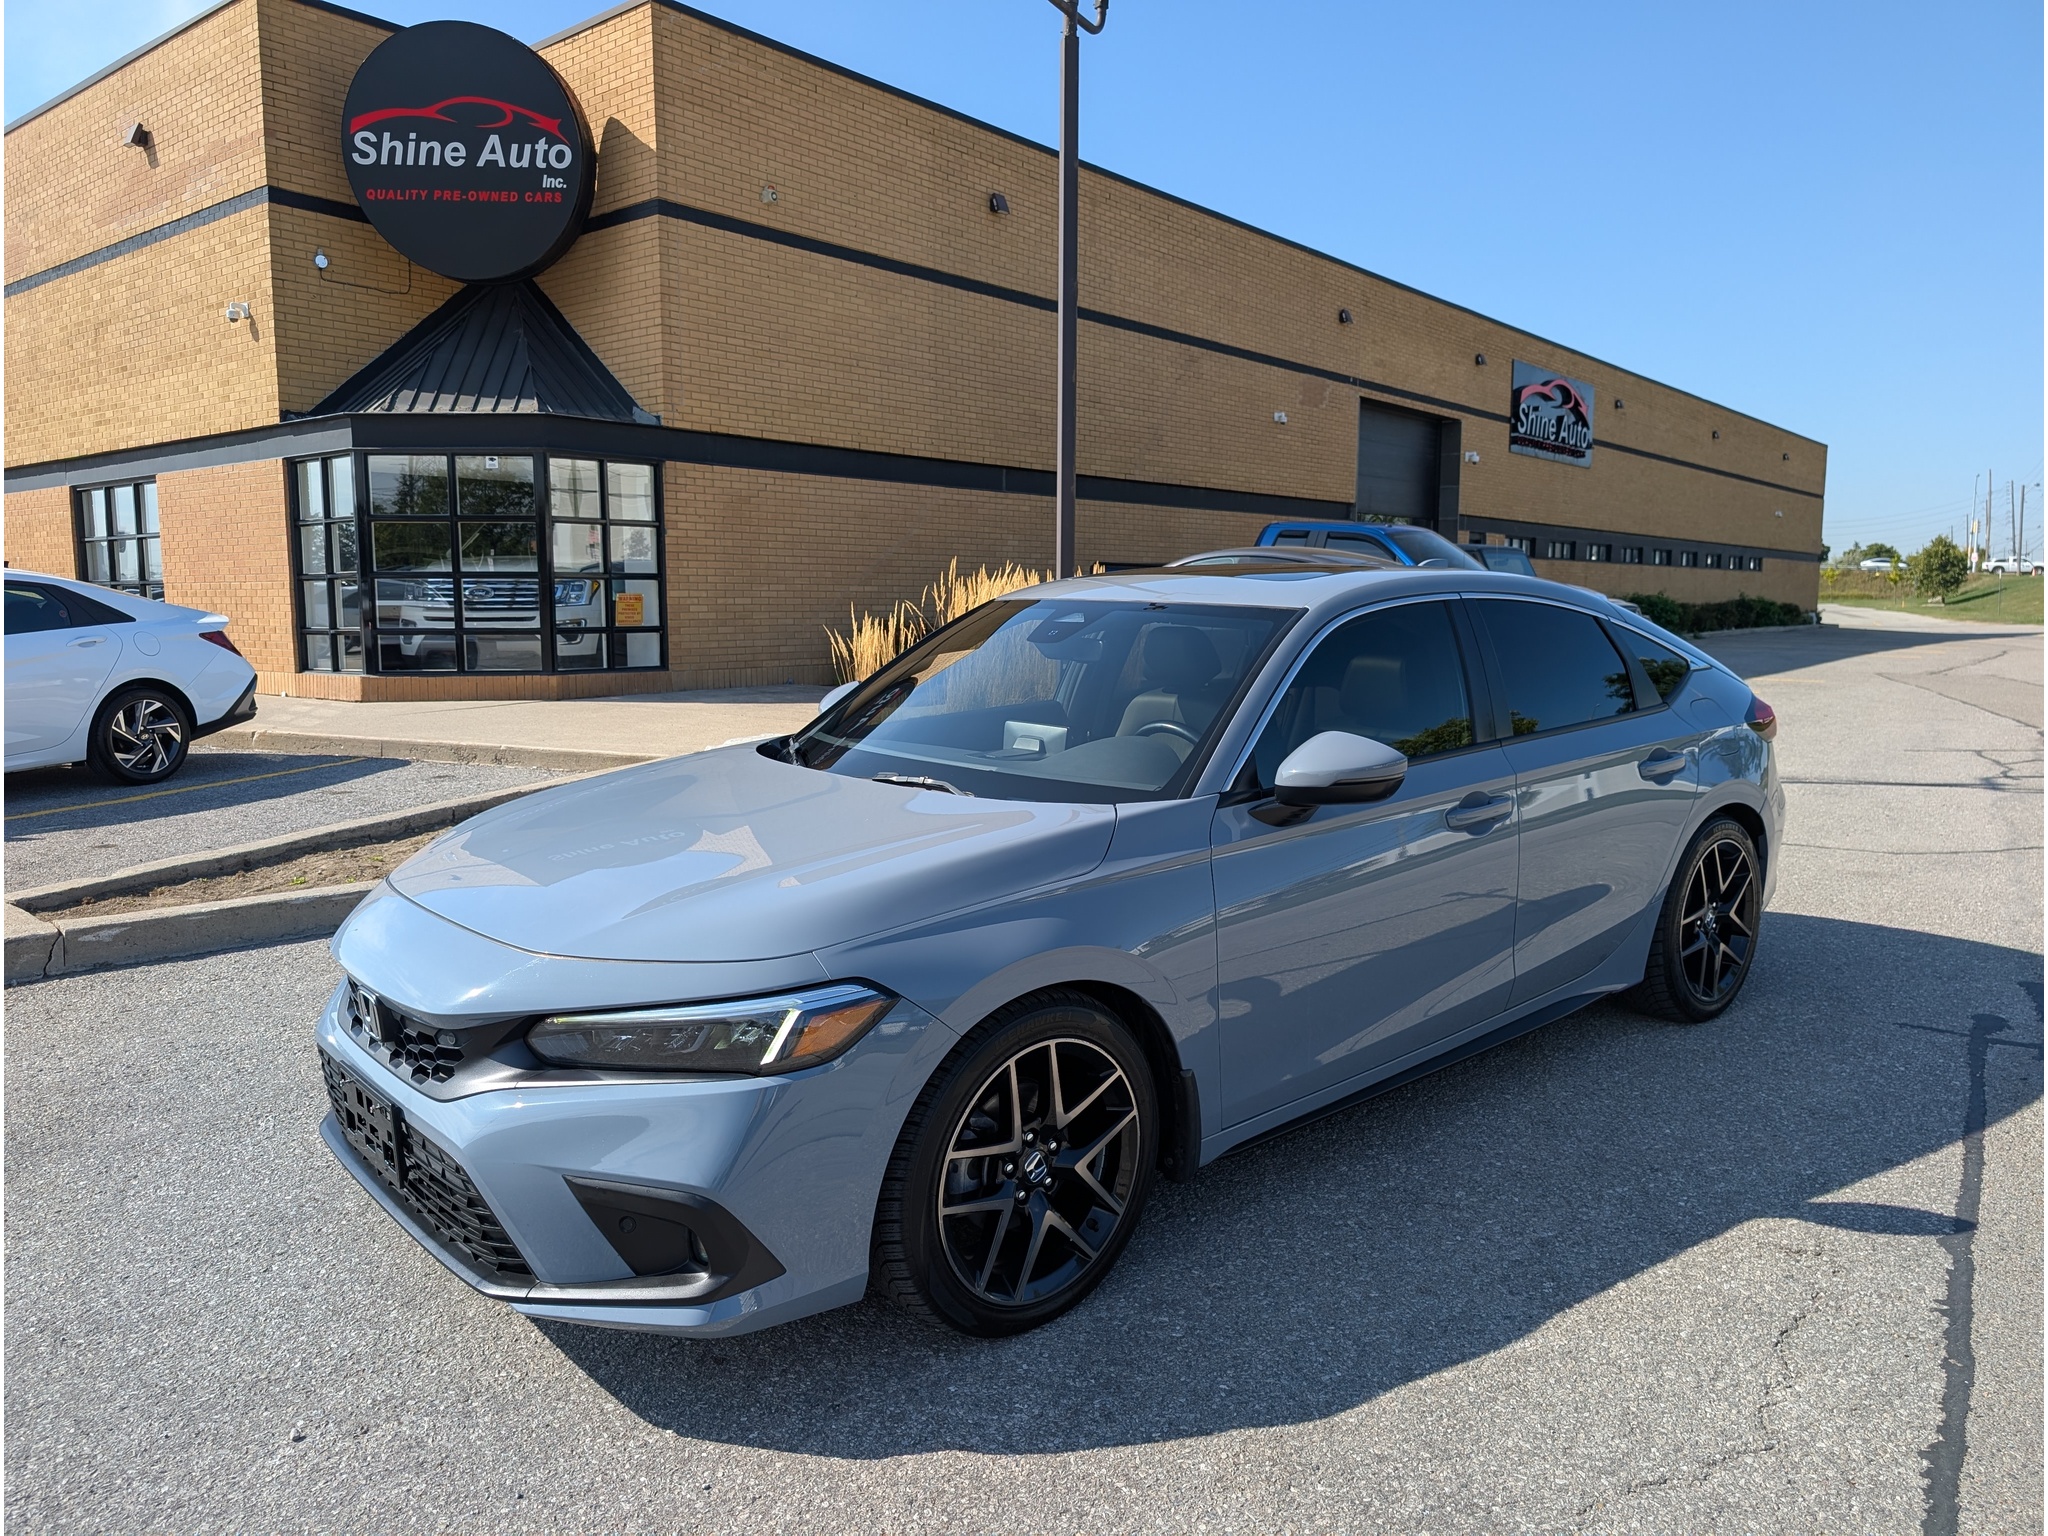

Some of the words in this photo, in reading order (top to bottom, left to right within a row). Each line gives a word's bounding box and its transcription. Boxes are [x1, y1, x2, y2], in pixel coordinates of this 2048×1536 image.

[351, 130, 466, 167] Shine
[476, 134, 573, 169] Auto
[542, 174, 567, 189] Inc.
[366, 188, 428, 200] QUALITY
[433, 190, 519, 202] PRE-OWNED
[524, 191, 563, 203] CARS
[1517, 403, 1557, 441] Shine
[1559, 415, 1590, 449] Auto
